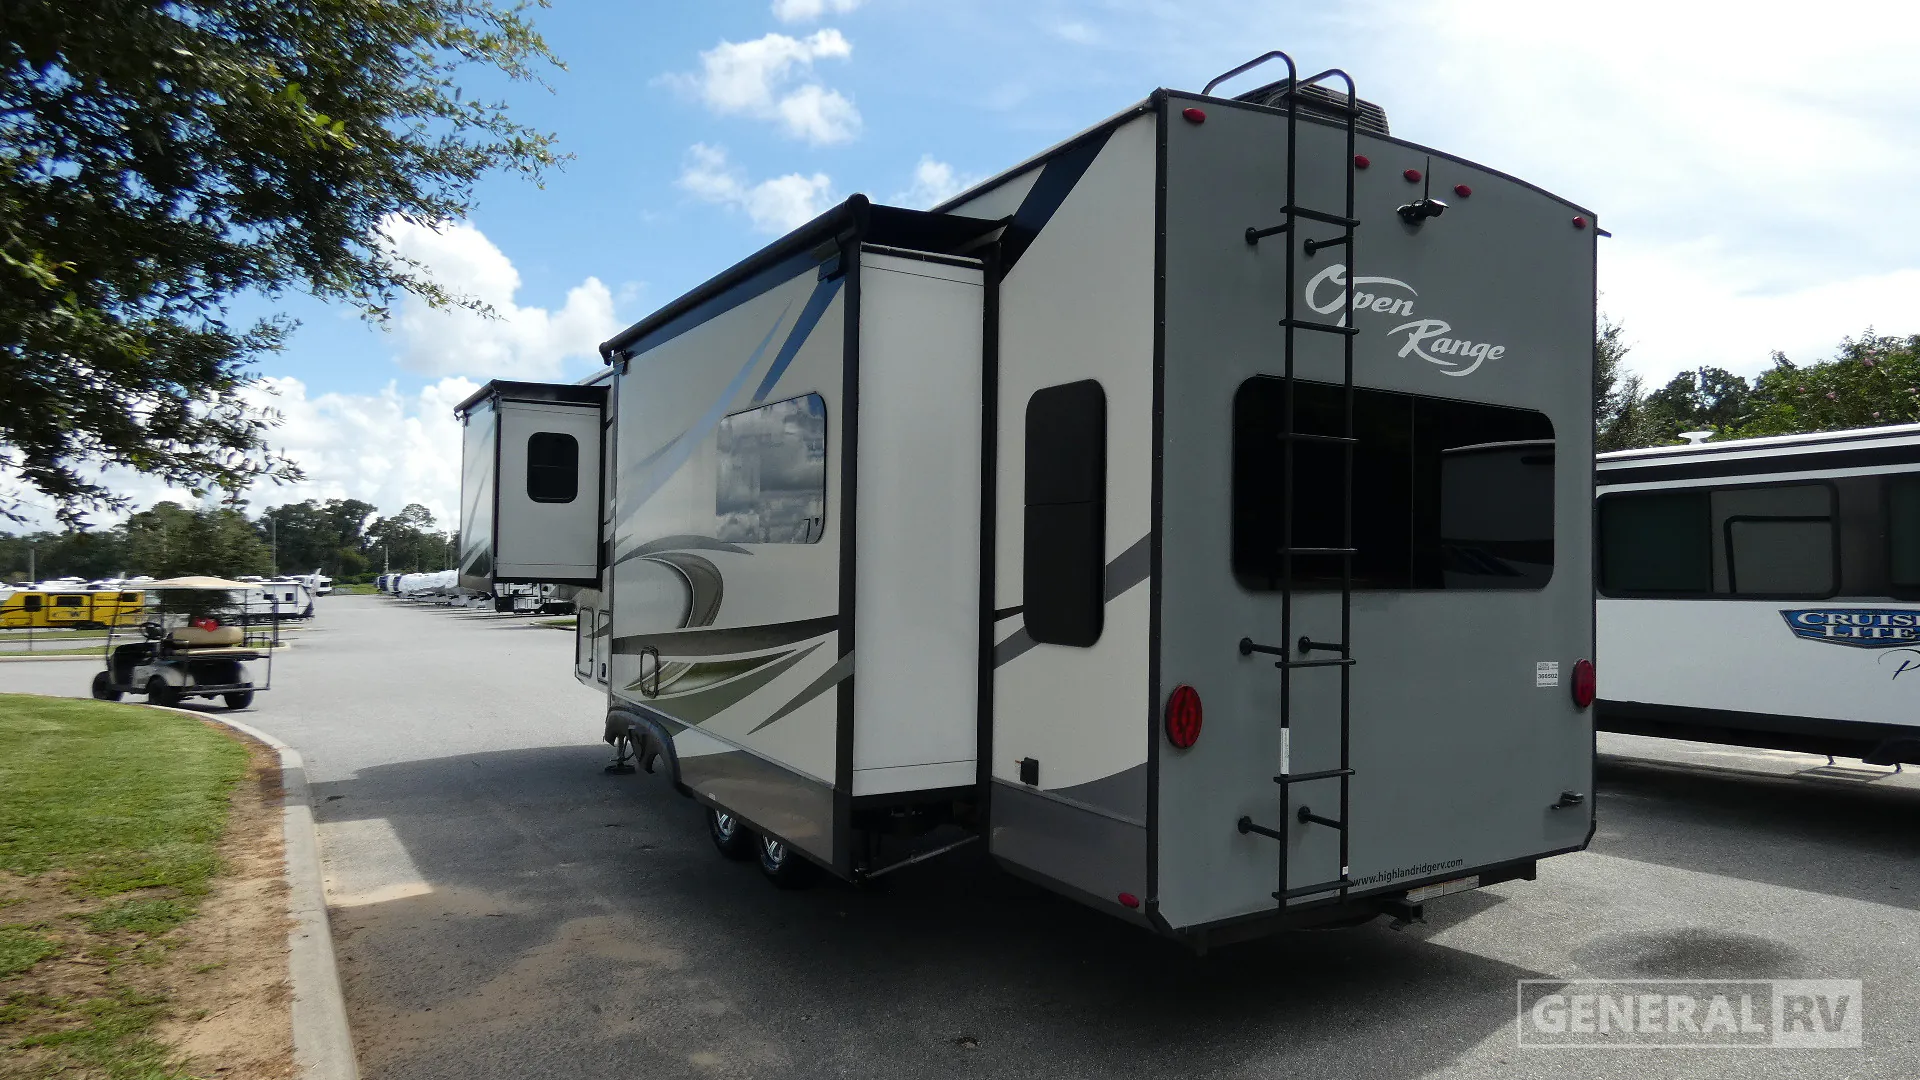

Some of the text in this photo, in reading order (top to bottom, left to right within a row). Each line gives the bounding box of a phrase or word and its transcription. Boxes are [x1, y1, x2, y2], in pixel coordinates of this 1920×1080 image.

[1305, 264, 1418, 328] Open
[1387, 319, 1506, 377] Range
[1823, 625, 1916, 639] LITE
[1352, 858, 1463, 887] www.highlandridgerv.com
